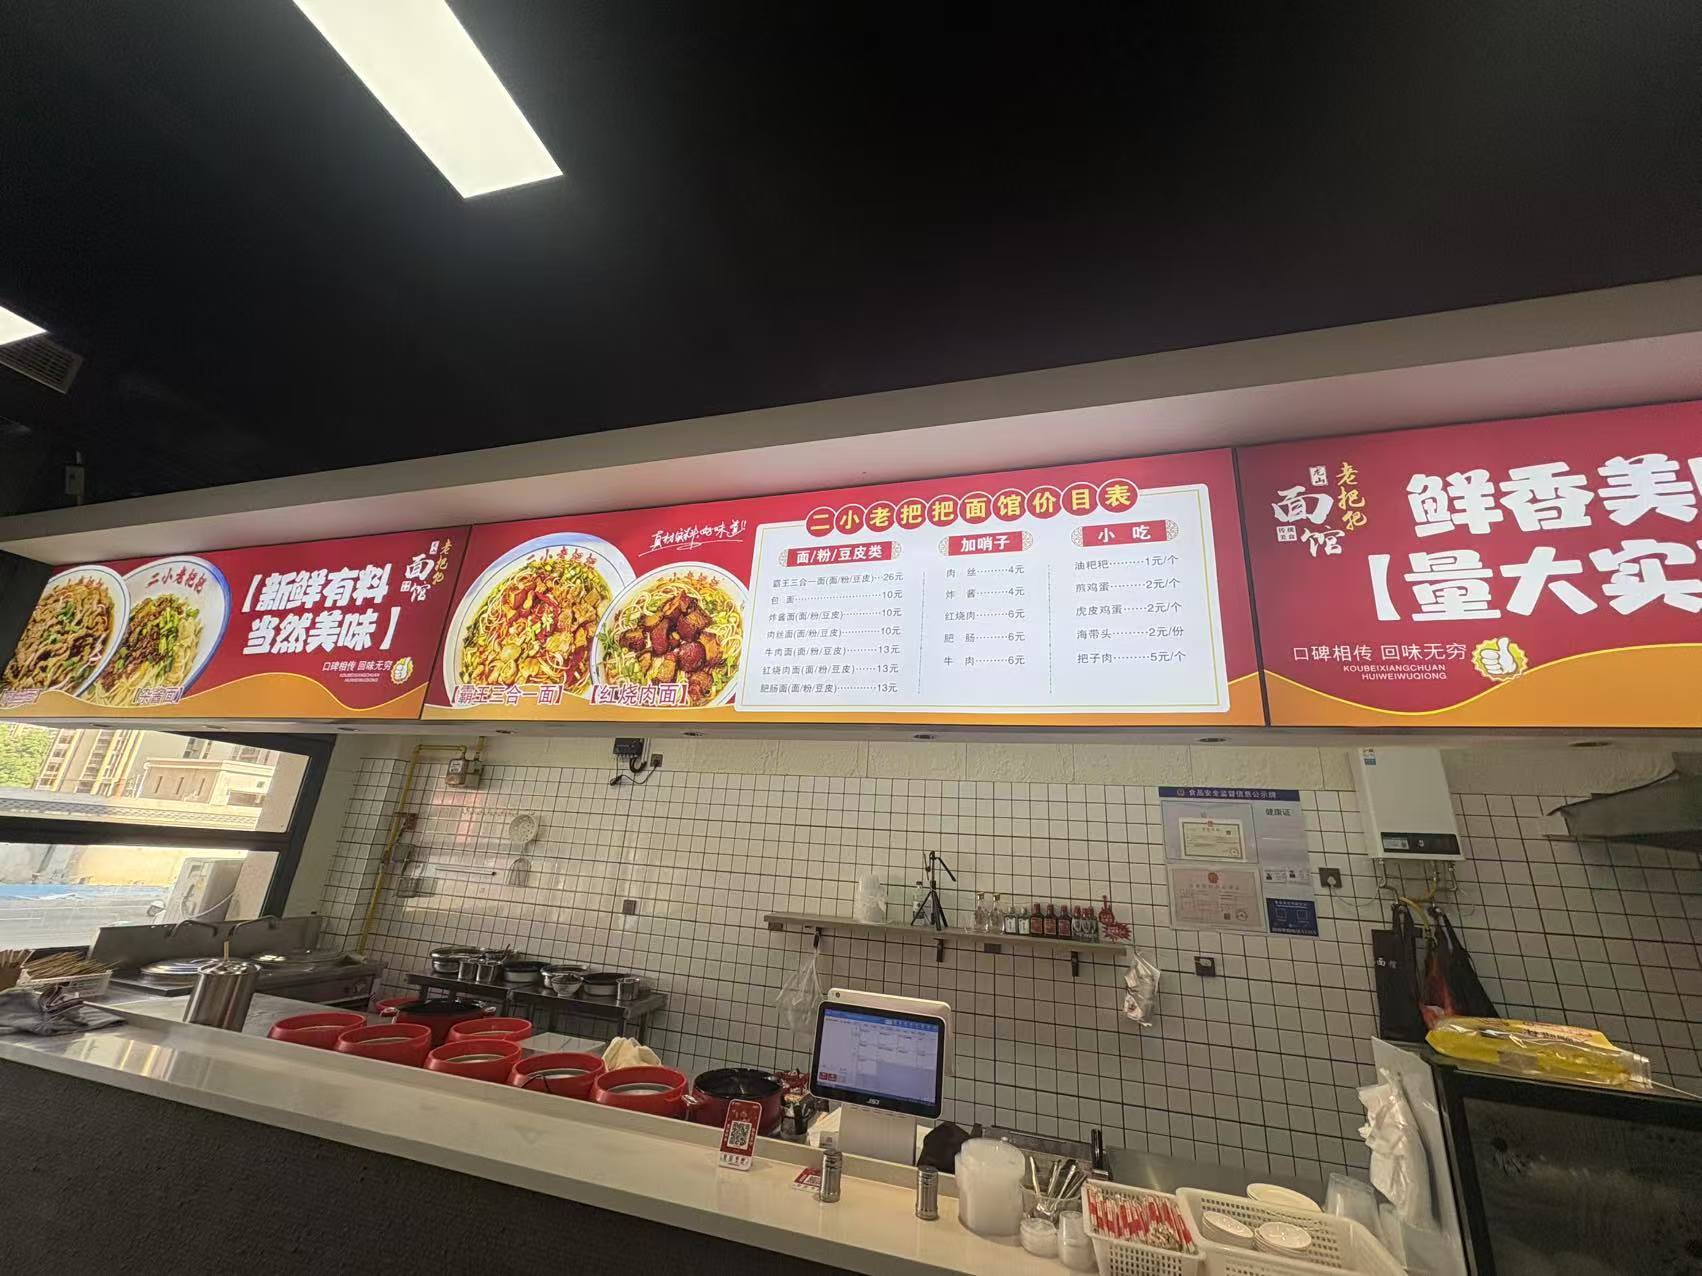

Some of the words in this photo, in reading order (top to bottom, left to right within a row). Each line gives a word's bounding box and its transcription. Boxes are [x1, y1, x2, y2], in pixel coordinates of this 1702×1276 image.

[1406, 453, 1702, 538] 鲜香美
[810, 483, 1136, 532] 二小老把把面馆价目表
[1271, 485, 1346, 558] 面馆
[960, 535, 1011, 552] 加哨子
[795, 546, 884, 564] 面/粉/豆皮类
[1145, 554, 1179, 566] 1元/个
[1008, 564, 1025, 574] 4元
[883, 572, 904, 582] 26元
[1367, 538, 1702, 622] 【量大实
[1145, 577, 1181, 589] 2元/个
[882, 589, 903, 599] 10元
[1008, 586, 1025, 597] 4元
[882, 607, 902, 617] 10元
[1007, 608, 1026, 619] 6元
[1075, 604, 1123, 617] 虎皮鸡蛋
[1146, 601, 1182, 613] 2元/个
[881, 626, 901, 636] 10元
[1007, 631, 1026, 642] 6元
[1076, 628, 1112, 640] 海带头
[1148, 626, 1185, 638] 2元/份
[879, 644, 901, 654] 13元
[1293, 643, 1373, 662] 口碑相传
[1380, 642, 1467, 661] 回味无穷
[1007, 654, 1026, 665] 6元
[1077, 652, 1113, 664] 把子肉
[1150, 650, 1187, 663] 5元/个
[877, 663, 899, 674] 13元
[1343, 664, 1446, 672] KOUBEIXIANGCHUAN
[1362, 672, 1448, 680] HUIWEIWUQIONG
[877, 682, 898, 693] 13元
